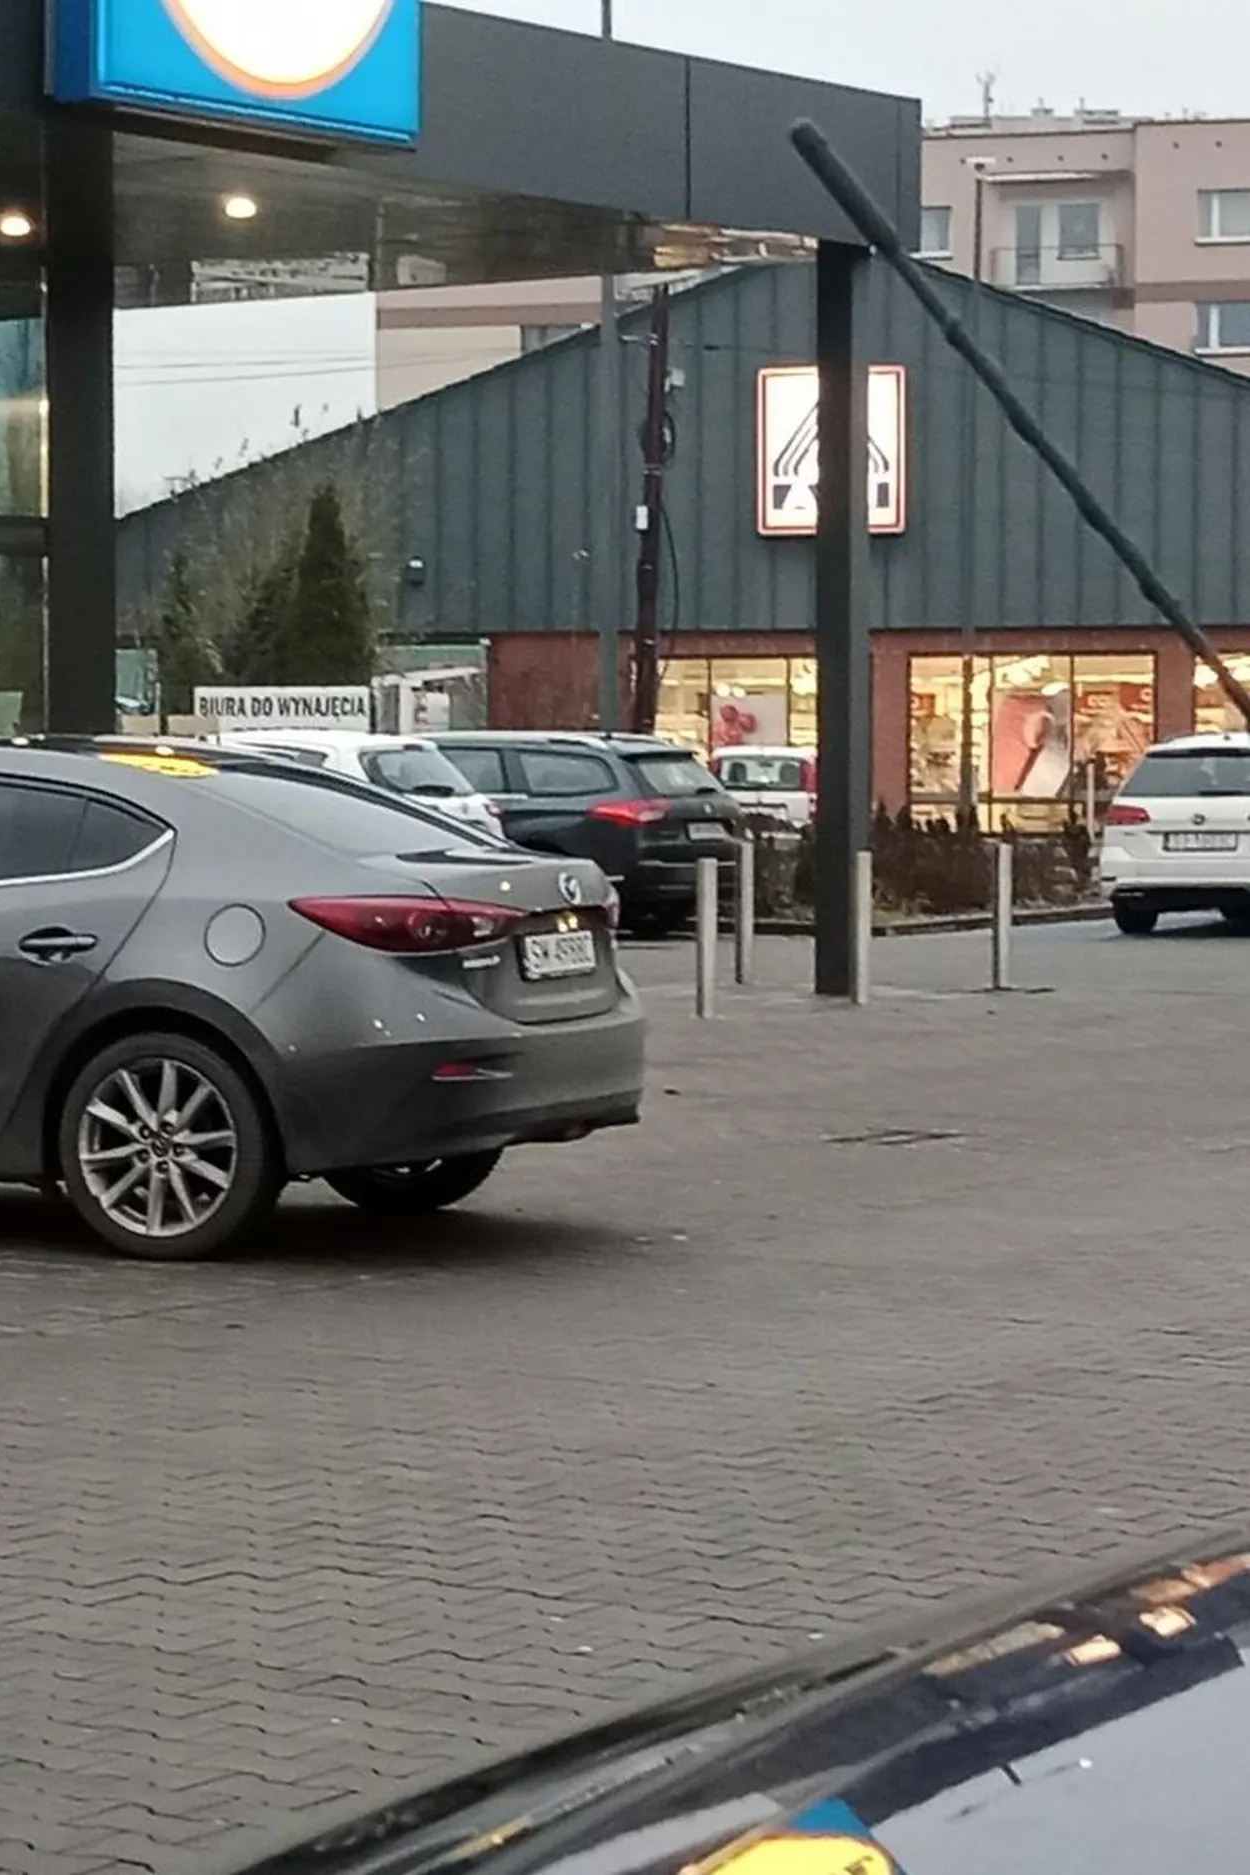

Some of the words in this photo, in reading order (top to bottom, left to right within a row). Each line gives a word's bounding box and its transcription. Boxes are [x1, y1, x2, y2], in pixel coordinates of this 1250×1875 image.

[198, 695, 248, 717] BIURA
[250, 696, 274, 717] DO
[277, 695, 367, 723] WYNAJĘCIA
